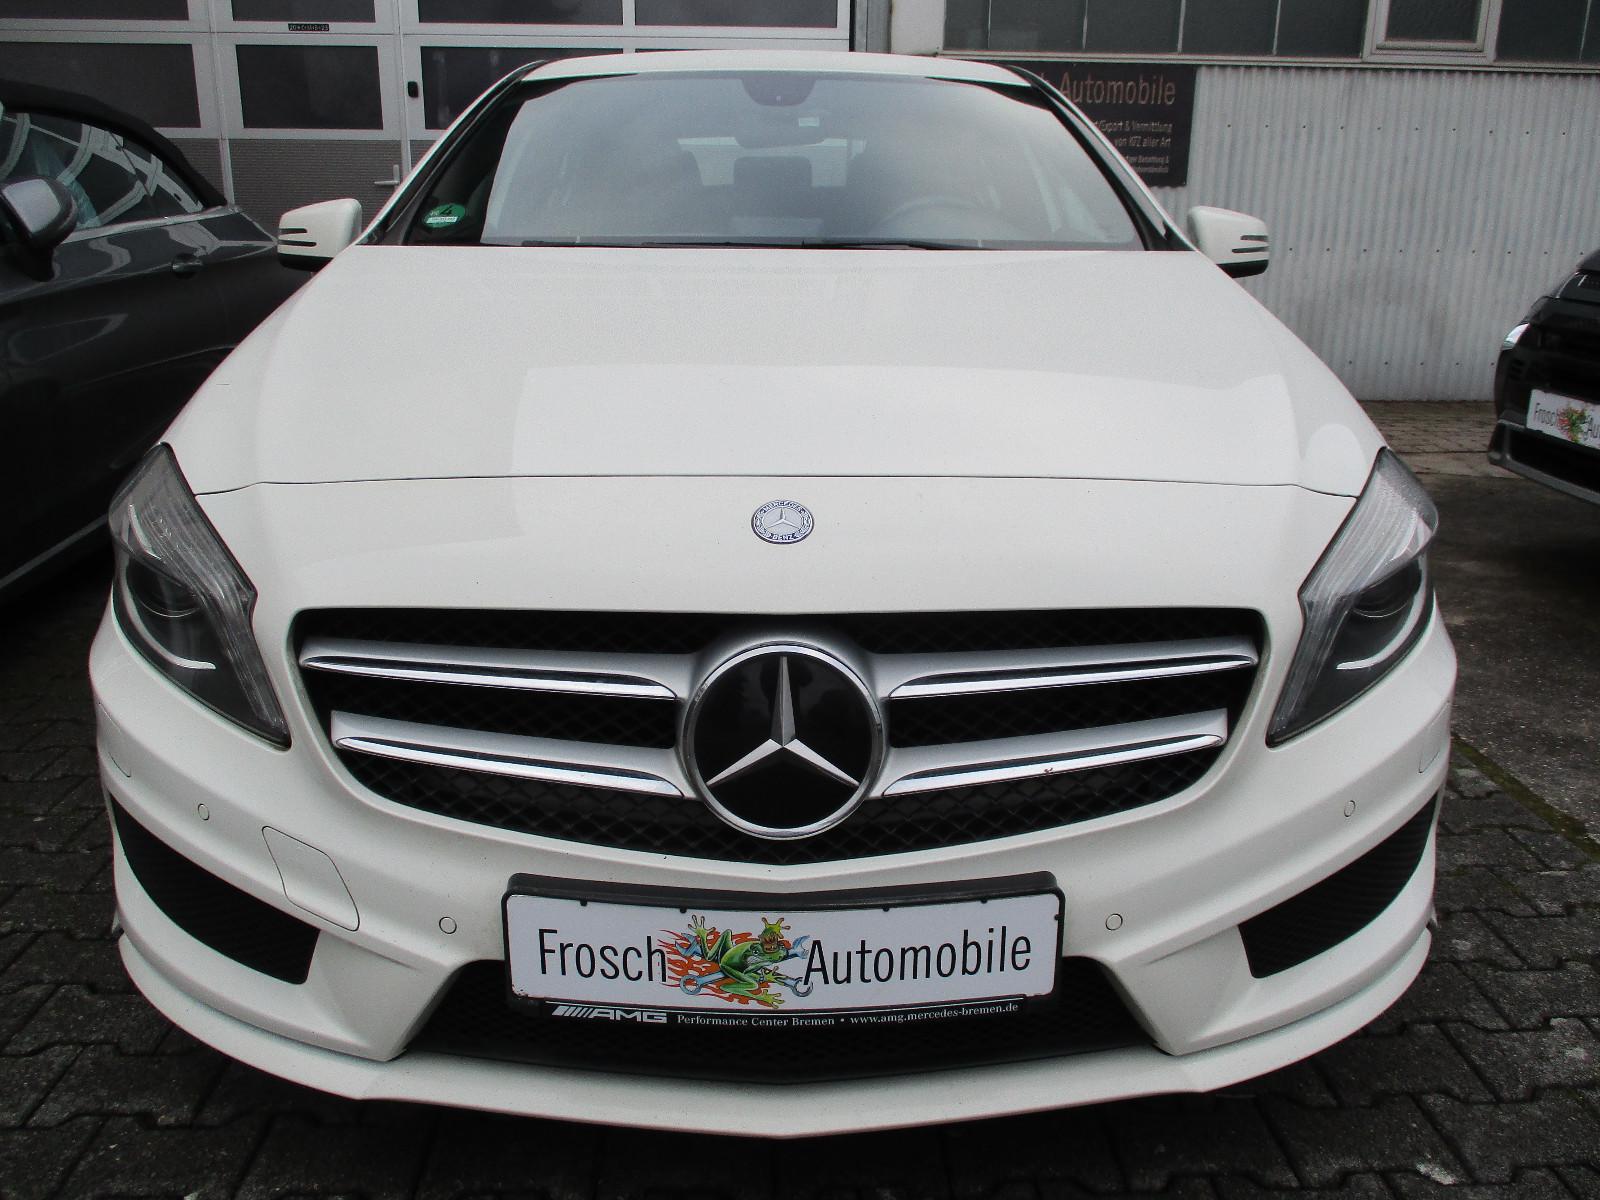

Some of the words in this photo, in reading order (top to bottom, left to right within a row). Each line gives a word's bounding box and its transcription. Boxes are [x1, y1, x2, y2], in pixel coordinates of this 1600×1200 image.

[1059, 71, 1176, 105] Automobile
[1129, 136, 1142, 147] KFZ
[1143, 136, 1159, 148] aller
[1160, 137, 1171, 148] Art
[439, 204, 453, 215] 4
[538, 928, 667, 983] Frosch
[803, 925, 1031, 985] Automobile
[590, 1007, 668, 1024] AMG
[677, 1014, 748, 1027] Performance
[751, 1017, 790, 1027] Center
[791, 1017, 836, 1027] Bremen
[850, 1003, 1019, 1025] www.amg.mercedes-bremen.de
